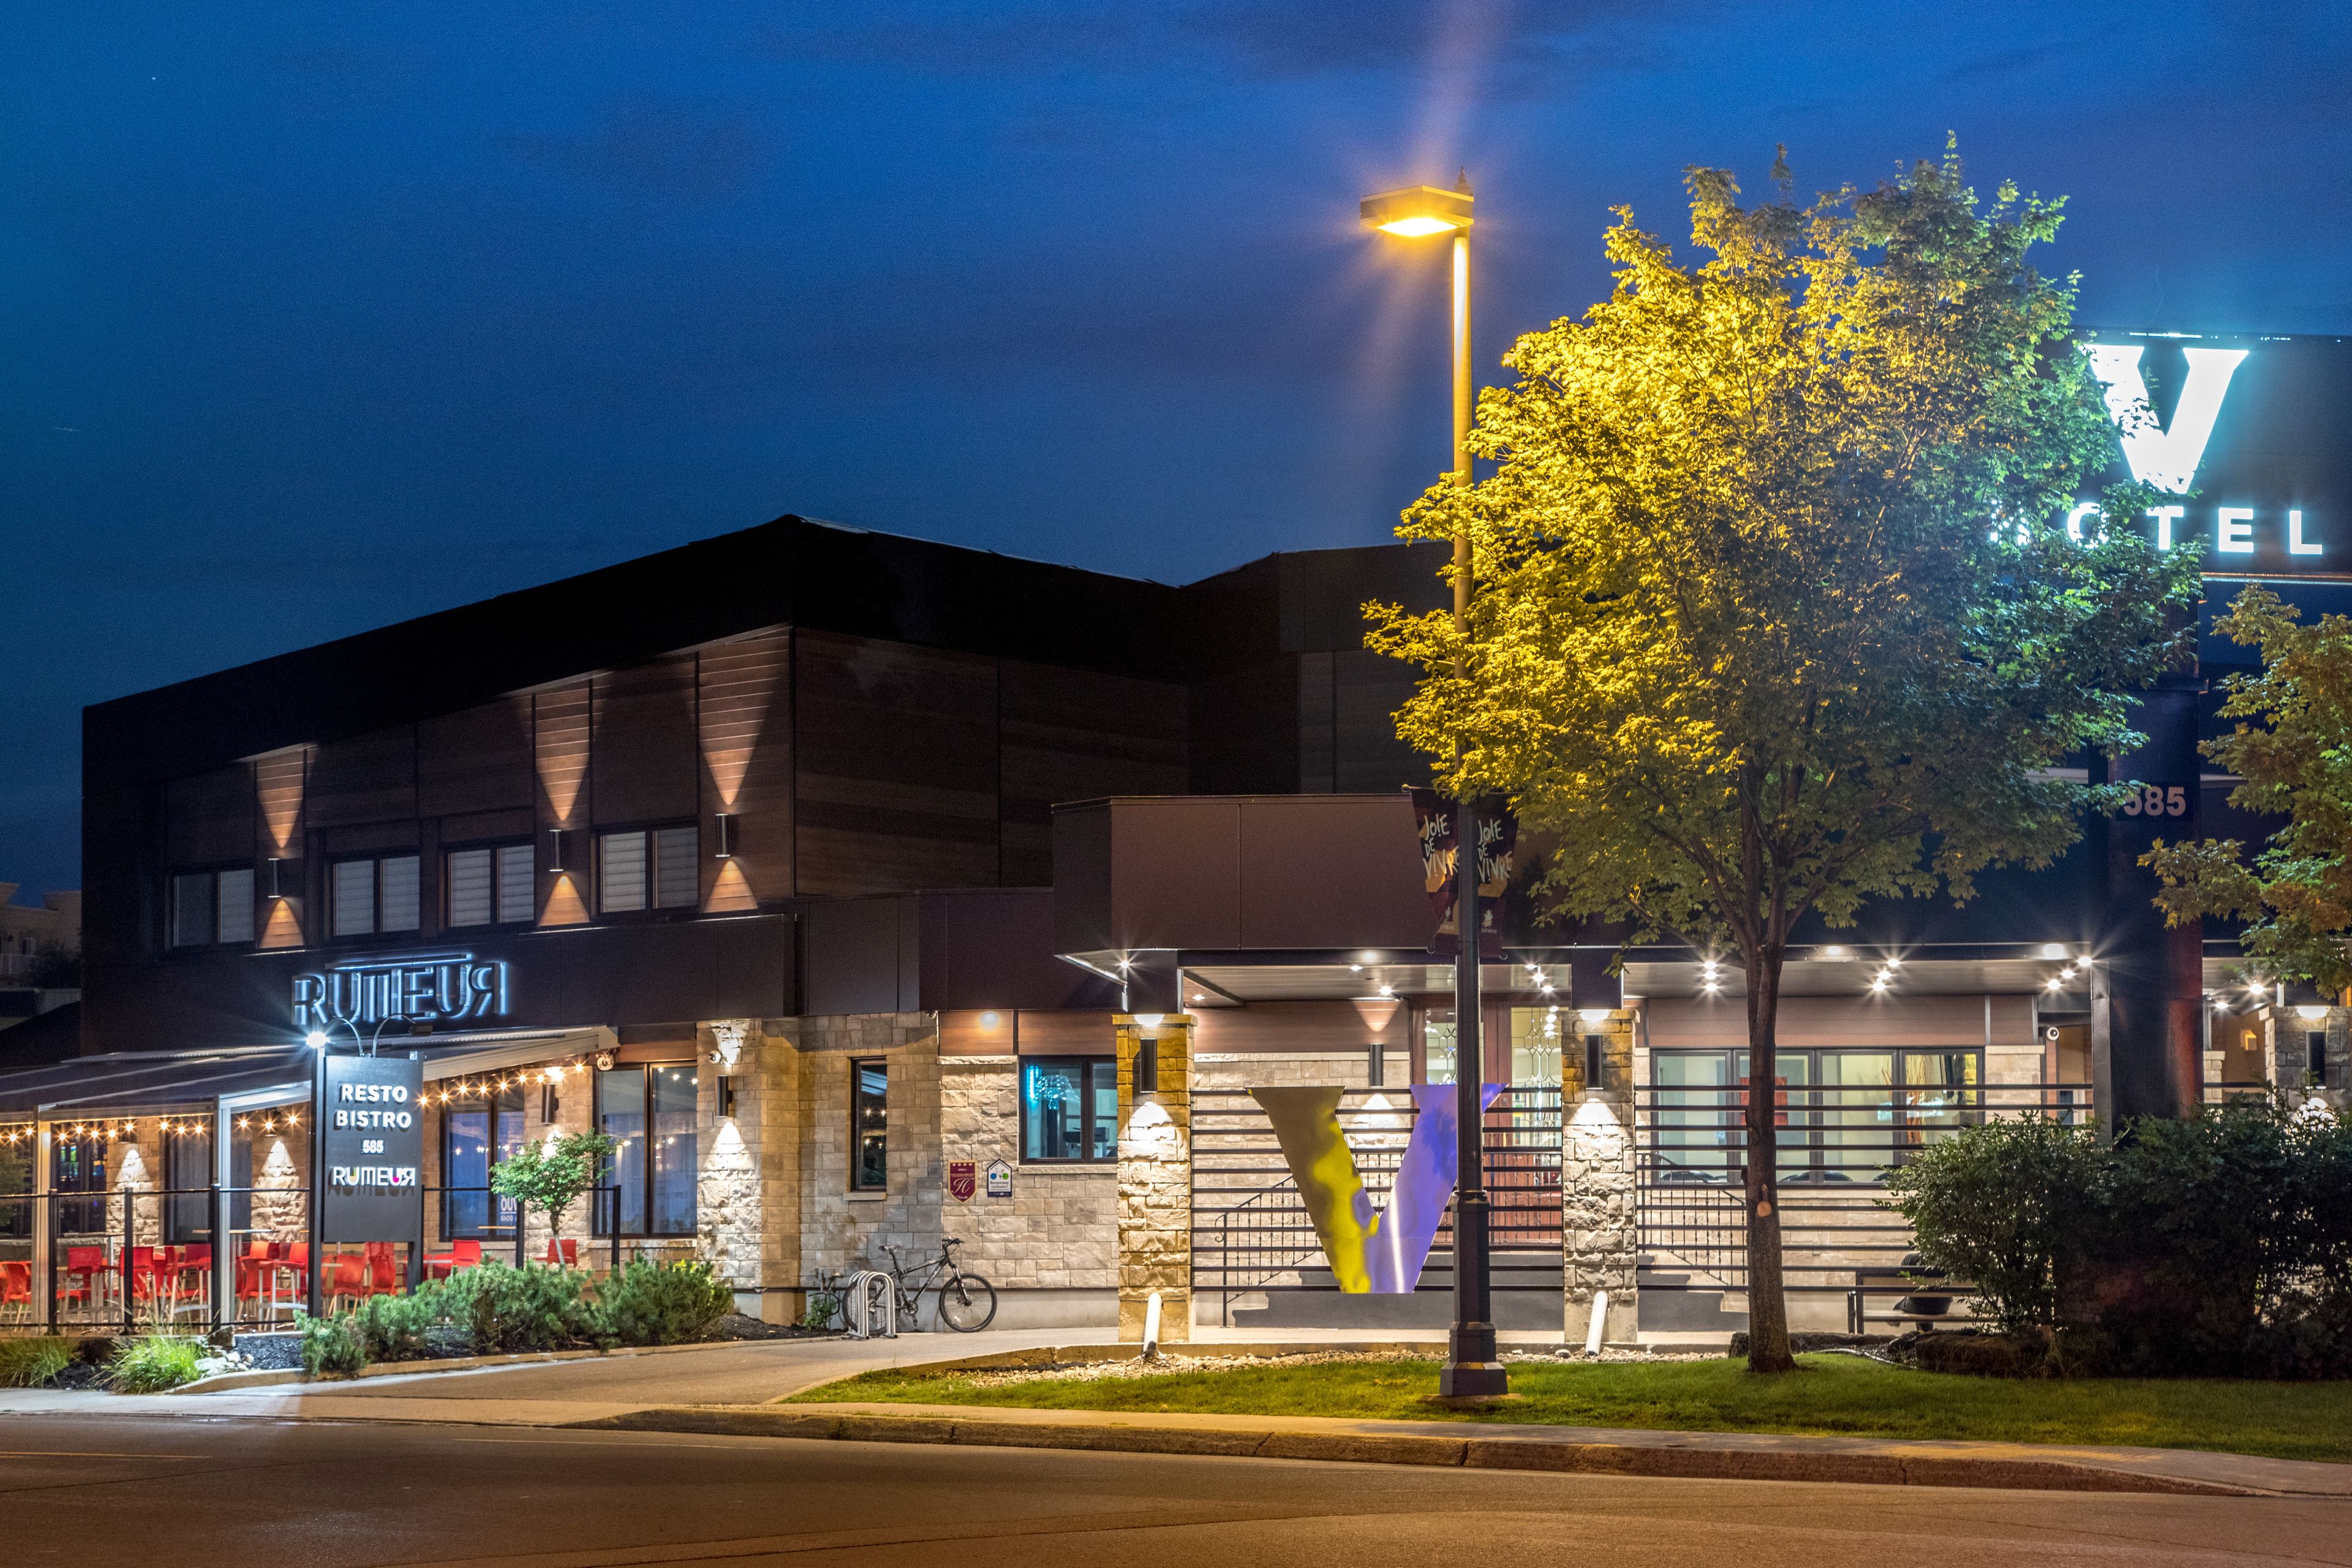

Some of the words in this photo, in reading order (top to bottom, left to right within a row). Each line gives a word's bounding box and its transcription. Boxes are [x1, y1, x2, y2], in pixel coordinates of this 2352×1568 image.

[2078, 344, 2250, 495] V
[2123, 786, 2186, 817] 585
[341, 1084, 408, 1103] RESTO
[336, 1110, 412, 1129] BISTRO
[362, 1139, 384, 1153] 585
